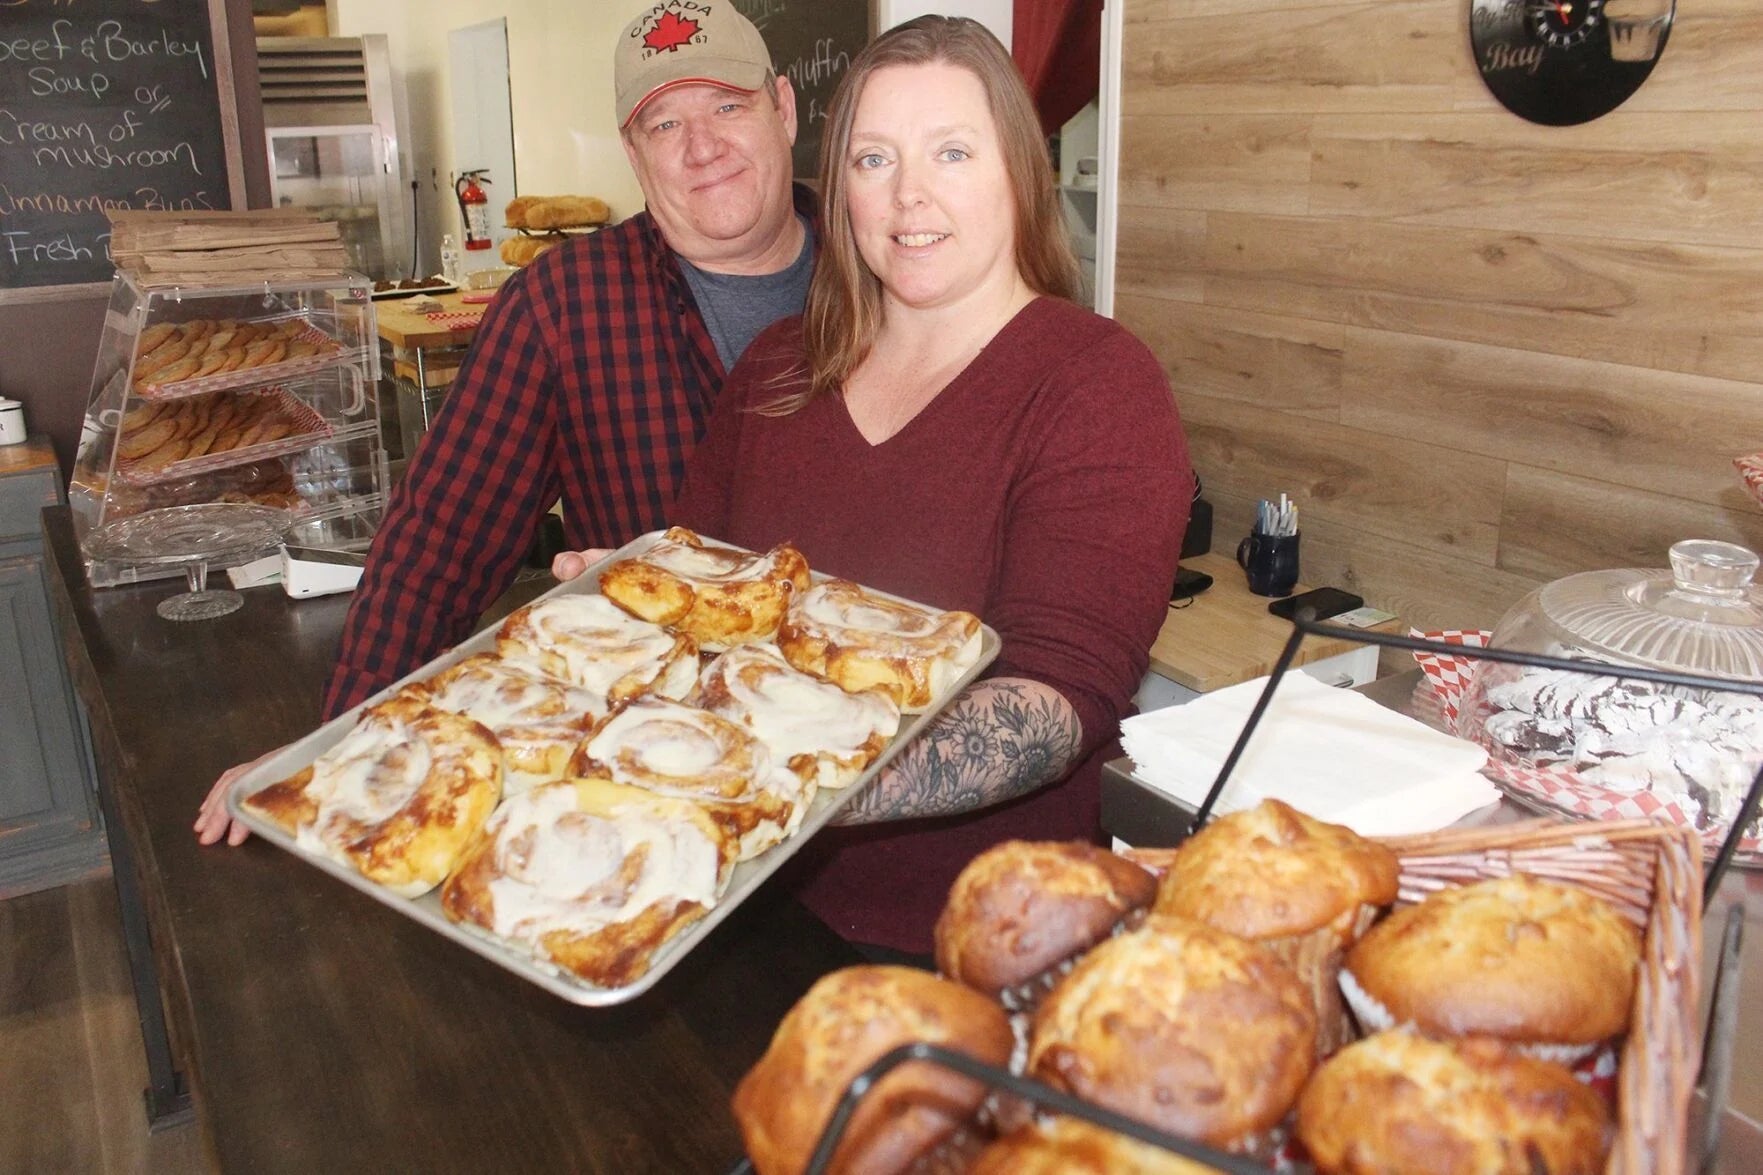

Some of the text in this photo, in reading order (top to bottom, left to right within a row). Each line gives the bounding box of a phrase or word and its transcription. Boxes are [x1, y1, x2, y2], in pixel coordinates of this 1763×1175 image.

[631, 0, 712, 38] CANADA
[97, 20, 207, 79] Barley
[1483, 42, 1545, 74] Bay
[28, 67, 109, 99] Soup
[109, 110, 143, 142] of
[2, 231, 93, 265] Fresh
